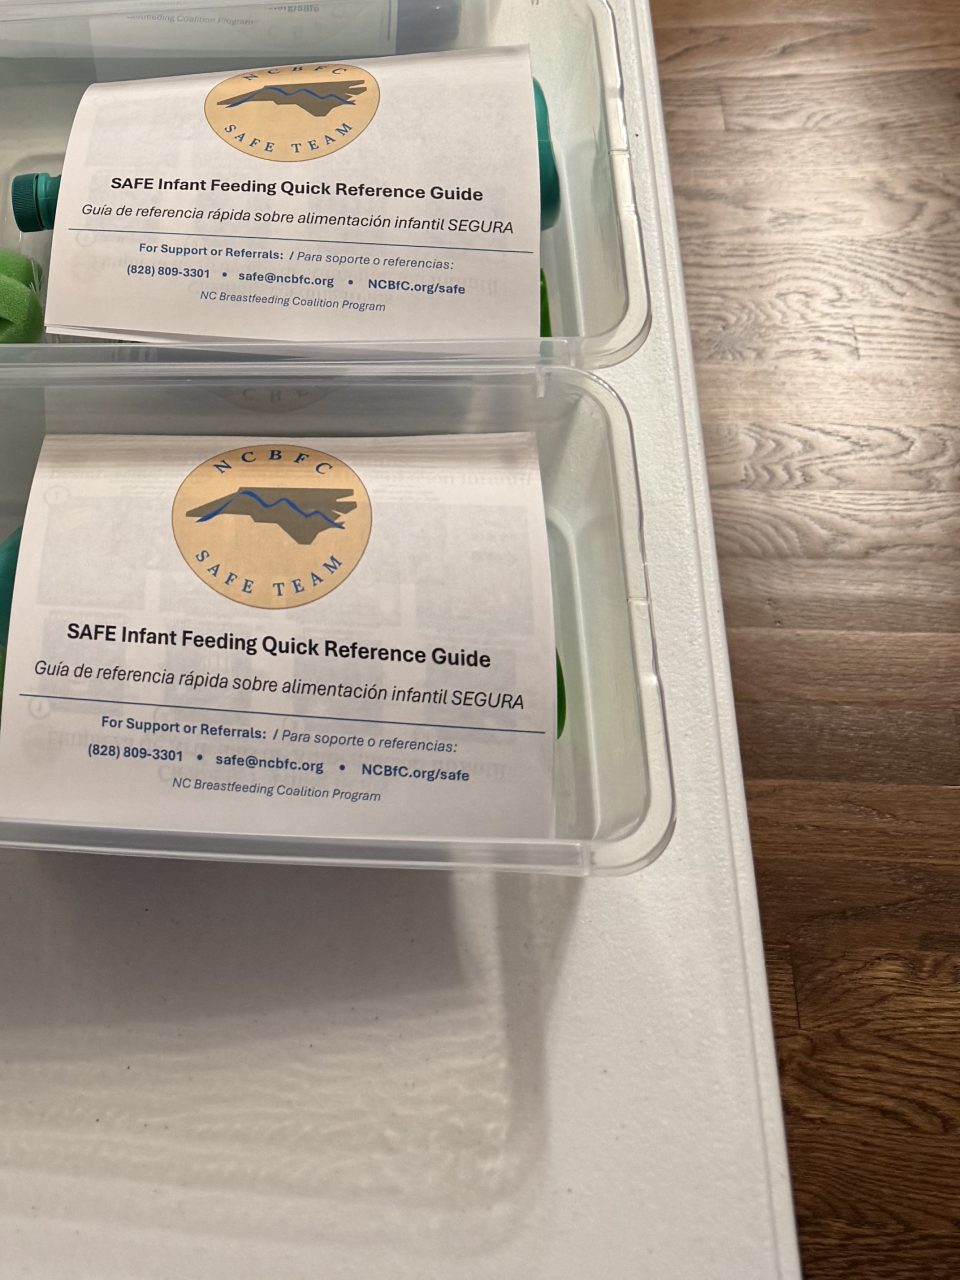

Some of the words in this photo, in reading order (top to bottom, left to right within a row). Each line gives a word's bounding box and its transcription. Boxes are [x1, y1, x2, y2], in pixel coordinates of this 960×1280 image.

[225, 124, 274, 153] SAFE
[291, 122, 353, 153] TEAM
[111, 178, 154, 189] SAFE
[158, 178, 206, 191] Infant
[211, 180, 276, 195] Feeding
[281, 181, 331, 195] Quick
[335, 183, 425, 199] Reference
[430, 187, 483, 201] Guide
[82, 204, 112, 216] Guía
[116, 206, 132, 217] de
[136, 207, 203, 219] referencia
[207, 209, 250, 223] rápida
[254, 211, 294, 223] sobre
[297, 213, 391, 228] alimentación
[394, 217, 445, 230] infantil
[448, 219, 514, 234] SEGURA
[139, 243, 157, 253] For
[160, 244, 207, 256] Support
[211, 247, 223, 256] or
[226, 247, 284, 260] Referrals:
[297, 252, 323, 262] Para
[325, 254, 370, 266] soporte
[383, 257, 453, 270] referencias:
[127, 265, 155, 276] (828)
[158, 266, 209, 278] 809-3301
[238, 270, 334, 288] safe@ncbfc.org
[368, 279, 465, 294] NCBfC.org/safe
[200, 291, 216, 300] NC
[220, 292, 289, 306] Breastfeeding
[292, 297, 339, 308] Coalition
[342, 300, 385, 312] Program
[213, 450, 333, 474] NCBFC
[196, 550, 254, 593] SAFE
[273, 555, 342, 596] TEAM
[67, 623, 116, 641] SAFE
[122, 627, 177, 645] Infant
[182, 631, 257, 655] Feeding
[262, 636, 319, 656] Quick
[325, 640, 426, 663] Reference
[432, 648, 491, 667] Guide
[34, 660, 69, 677] Guía
[74, 663, 92, 678] de
[97, 666, 174, 684] referencia
[179, 672, 228, 689] rápida
[233, 676, 277, 692] sobre
[282, 679, 387, 700] alimentación
[392, 686, 447, 704] infantil
[452, 691, 524, 709] SEGURA
[101, 716, 123, 728] For
[126, 718, 179, 733] Support
[184, 724, 197, 734] or
[201, 724, 266, 739] Referrals:
[282, 730, 310, 742] Para
[314, 733, 364, 747] soporte
[379, 738, 458, 752] referencias:
[88, 744, 120, 759] (828)
[123, 747, 183, 761] 809-3301
[215, 753, 324, 774] safe@ncbfc.org
[362, 764, 470, 782] NCBfC.org/safe
[172, 778, 191, 789] NC
[194, 779, 274, 796] Breastfeeding
[277, 785, 329, 798] Coalition
[332, 789, 381, 802] Program
